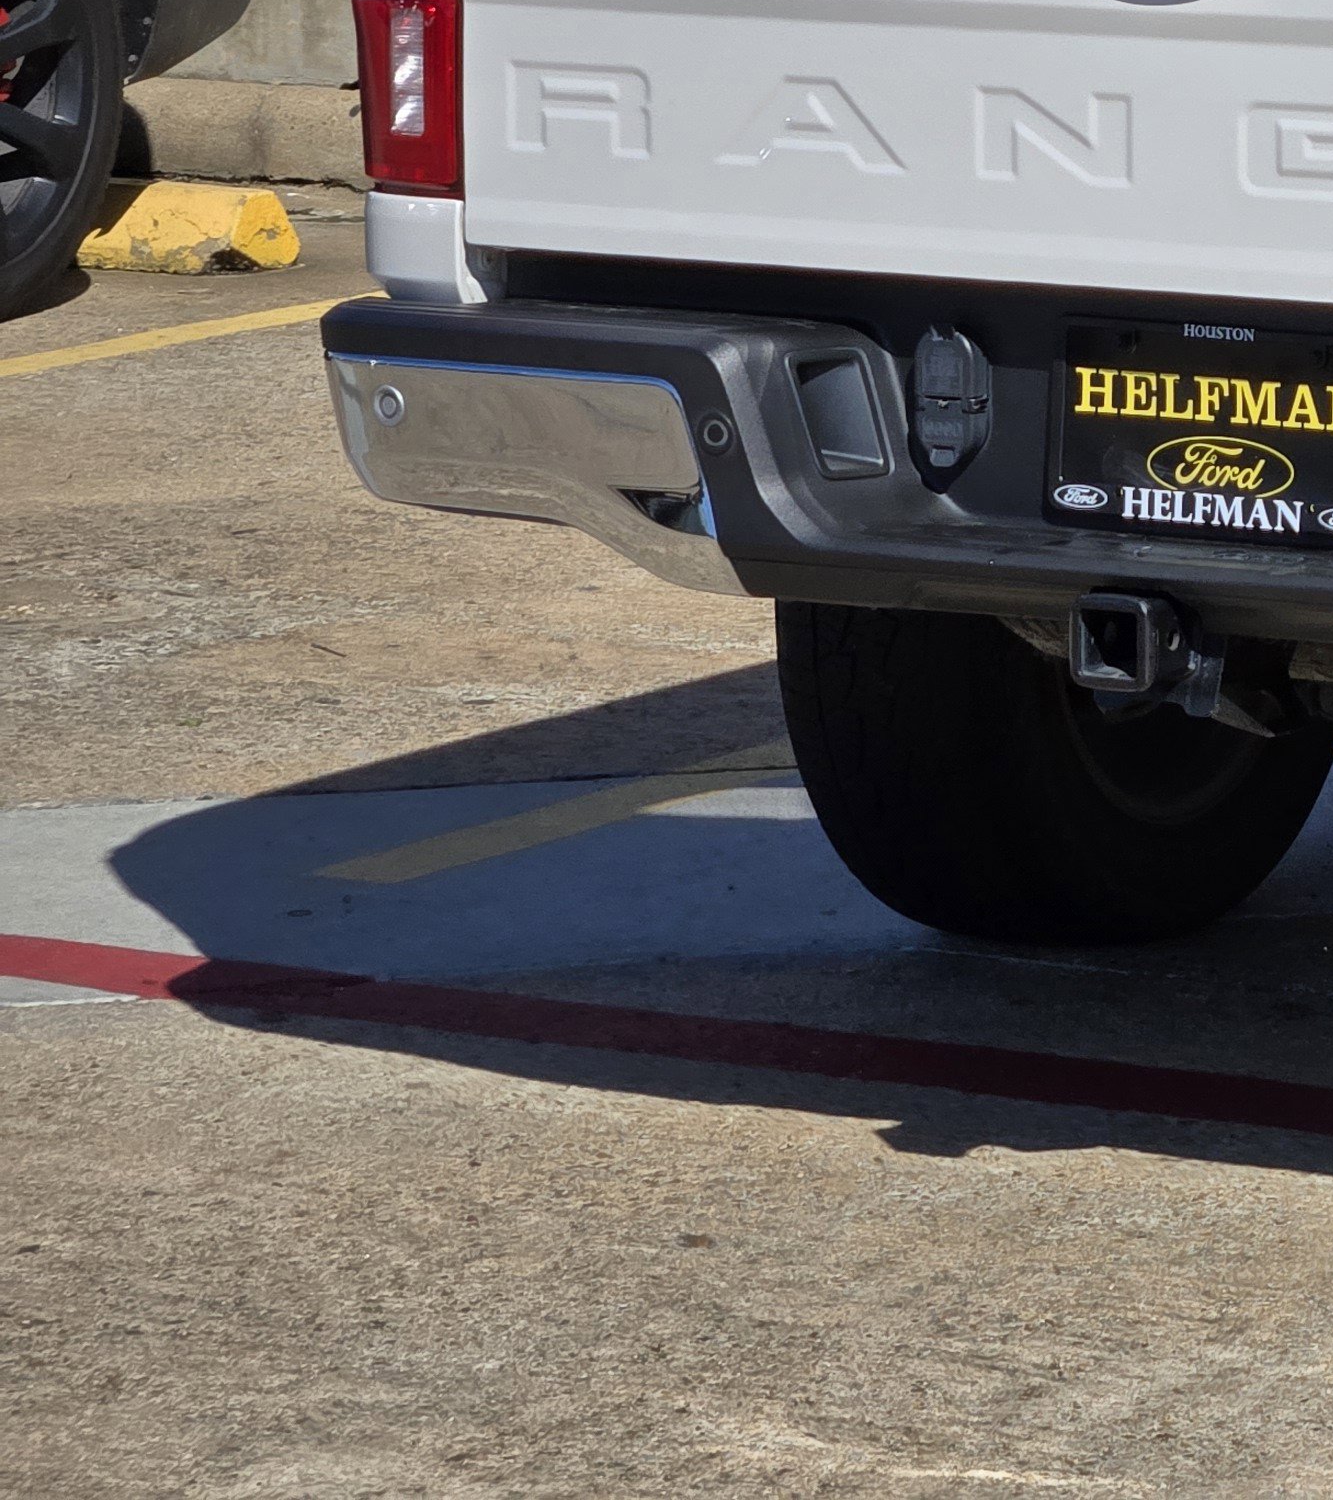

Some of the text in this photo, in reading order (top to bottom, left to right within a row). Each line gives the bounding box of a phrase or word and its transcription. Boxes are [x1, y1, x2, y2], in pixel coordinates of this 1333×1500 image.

[1183, 323, 1256, 342] HOUSTON
[1174, 442, 1267, 491] Ford
[1063, 487, 1098, 507] Ford
[1121, 486, 1305, 534] HELFMAN
